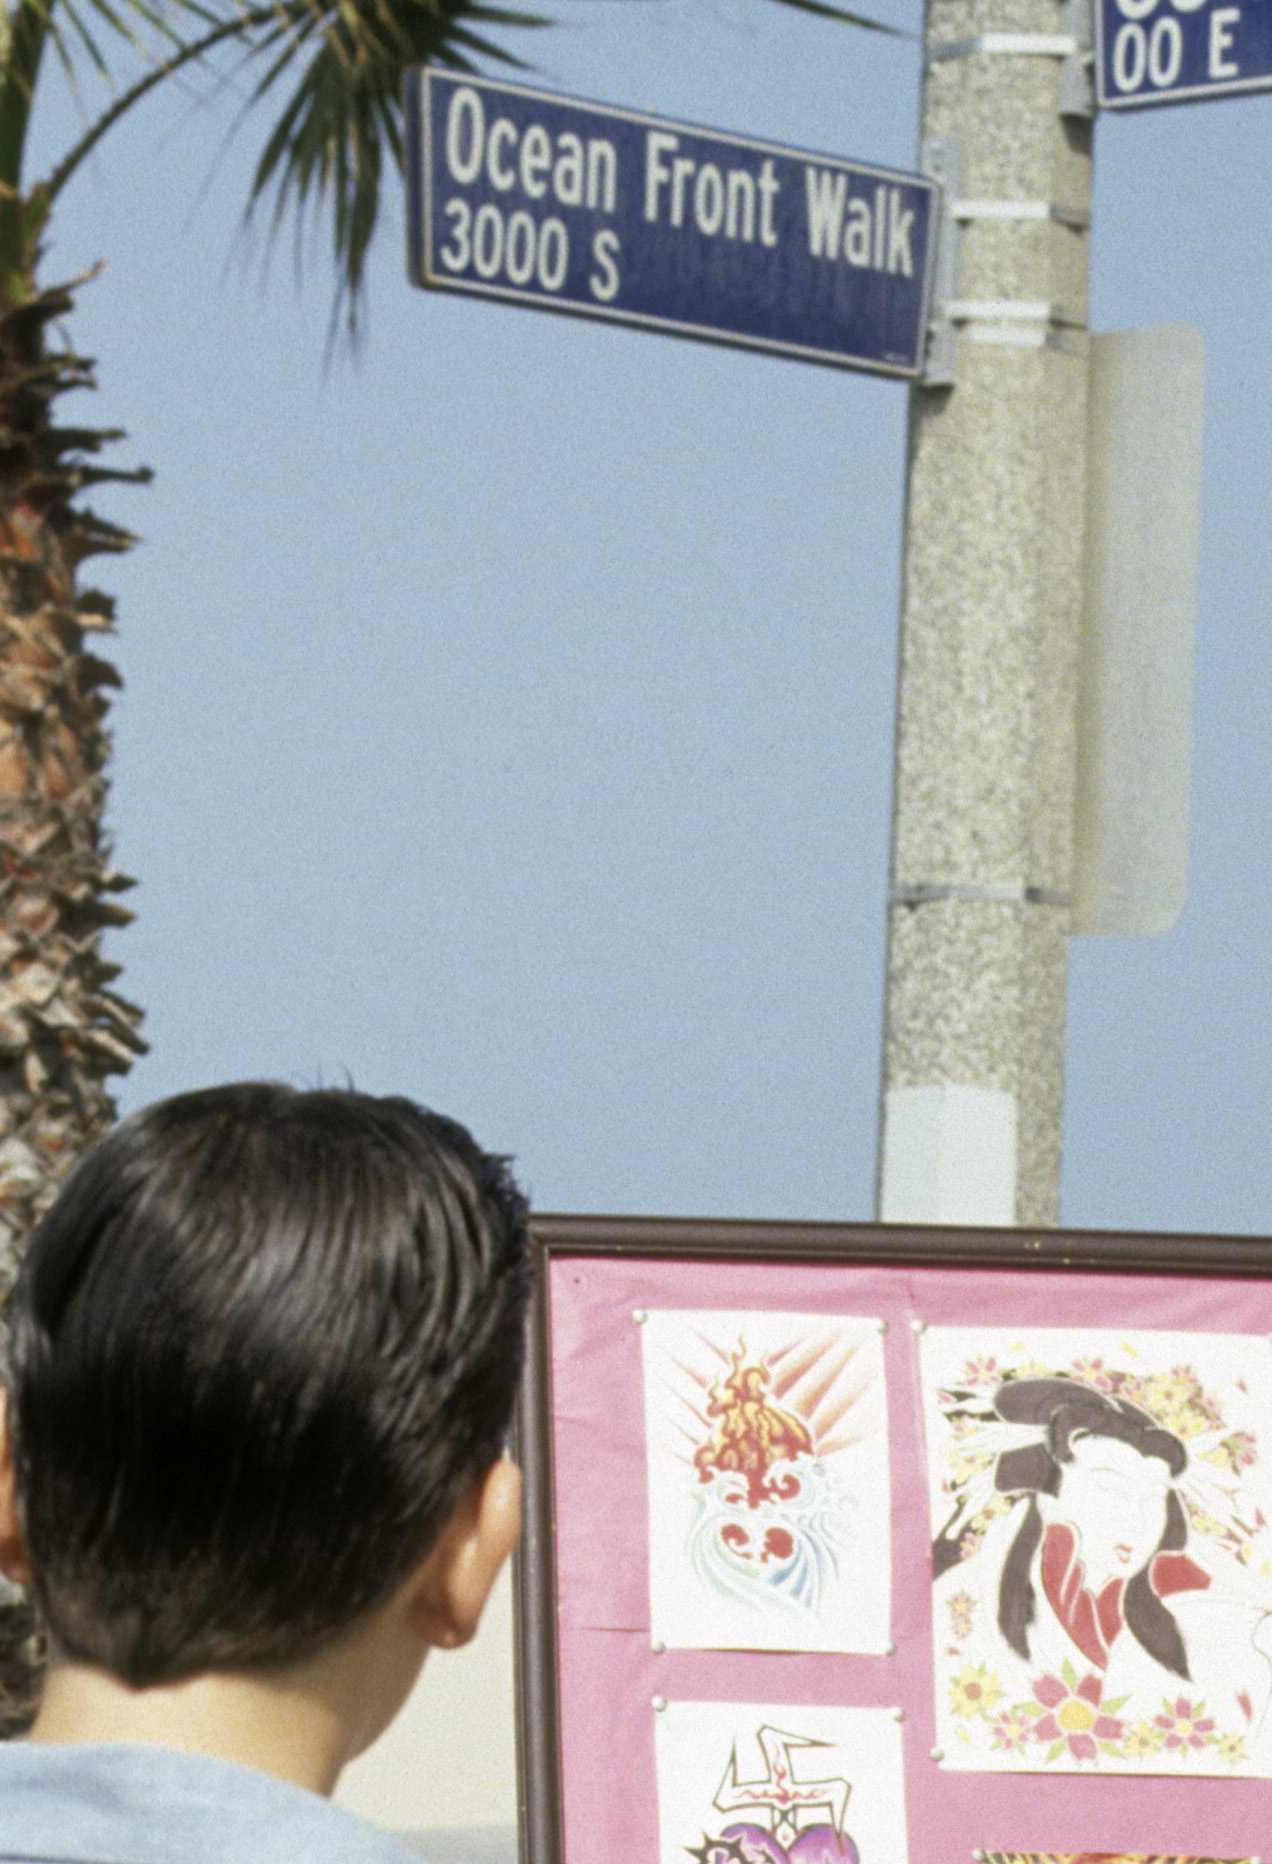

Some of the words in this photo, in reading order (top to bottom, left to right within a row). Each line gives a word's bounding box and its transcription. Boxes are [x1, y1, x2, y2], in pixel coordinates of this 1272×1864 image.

[1113, 15, 1183, 92] 00
[1208, 7, 1241, 79] E
[445, 86, 618, 213] Ocean
[644, 130, 780, 247] Front
[805, 165, 916, 278] Walk
[440, 198, 569, 291] 3000
[590, 229, 620, 300] S
